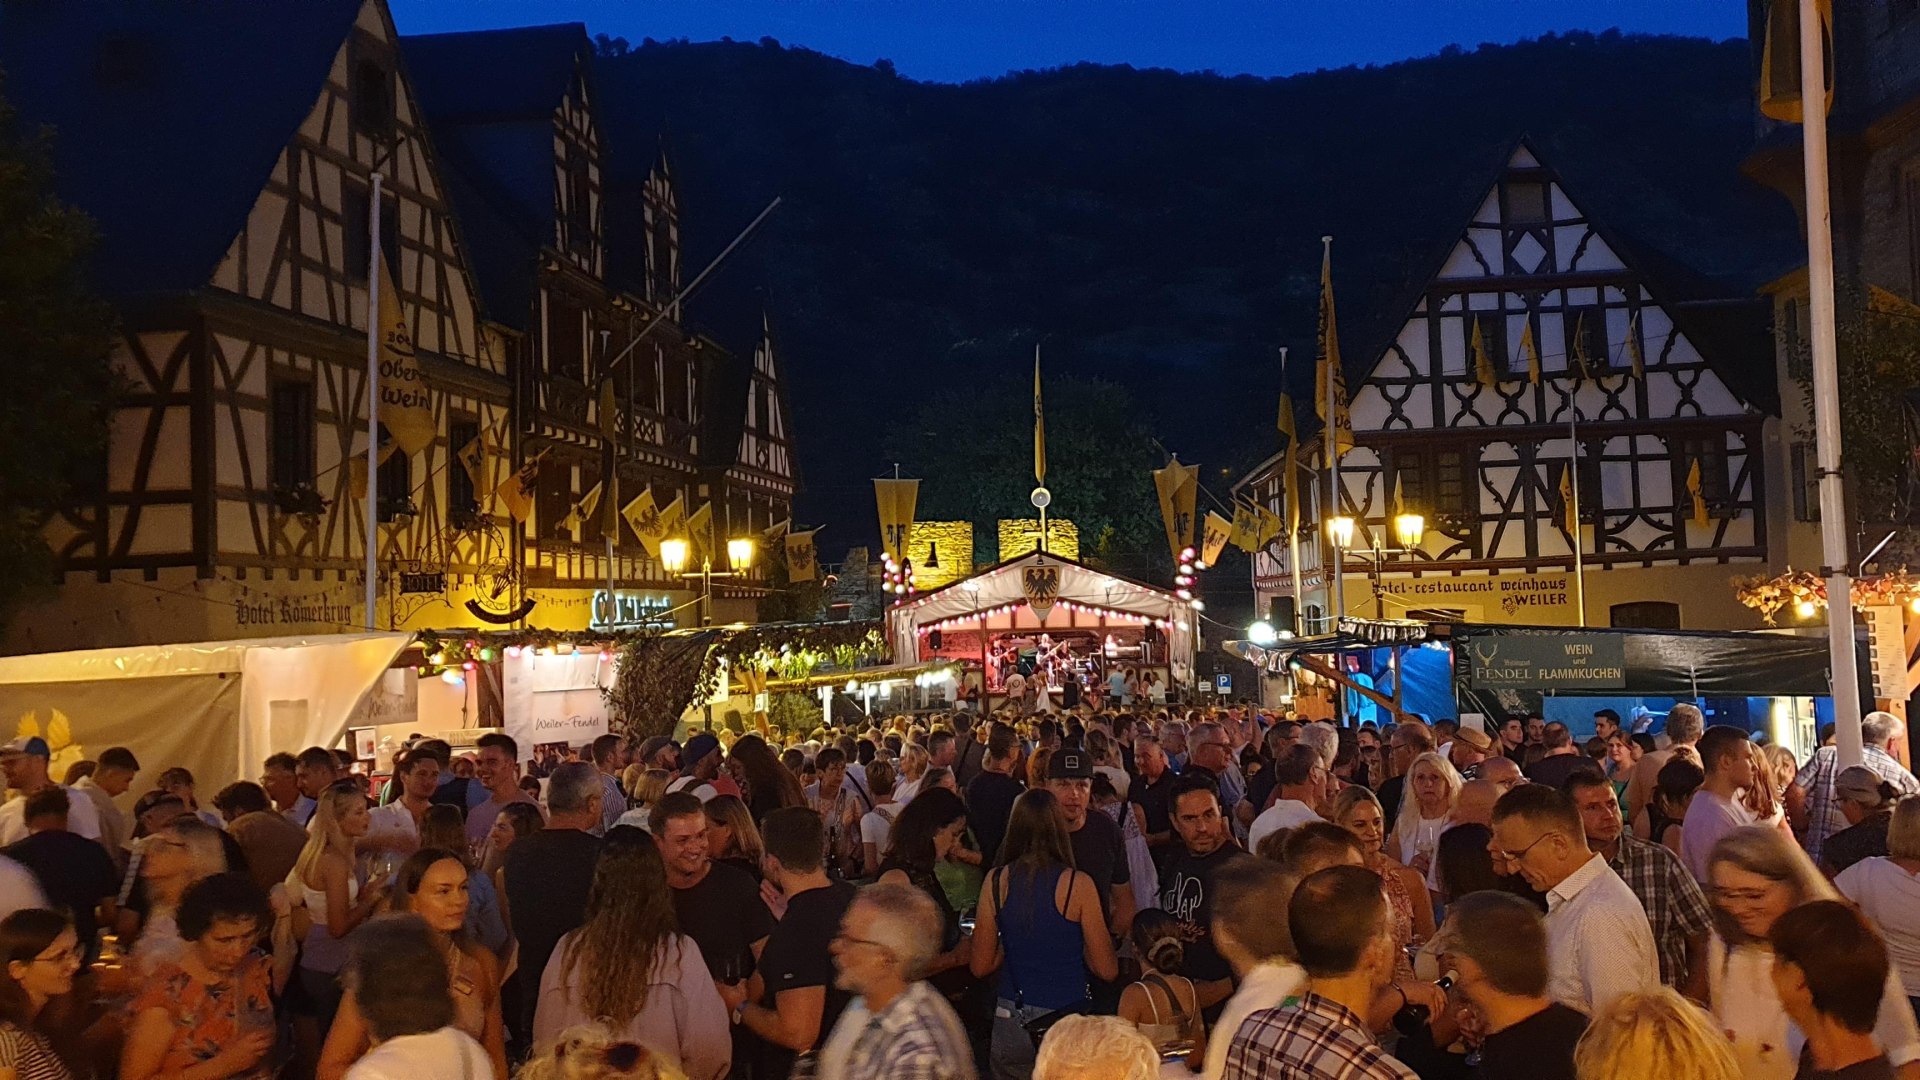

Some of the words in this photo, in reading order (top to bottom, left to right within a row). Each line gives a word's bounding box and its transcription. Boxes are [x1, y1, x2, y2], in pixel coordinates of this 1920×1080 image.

[1501, 576, 1567, 592] weinhaus
[1515, 593, 1567, 606] WEILER
[1564, 644, 1593, 655] WEIN
[1572, 657, 1586, 665] und
[1476, 667, 1532, 680] FENDEL
[1539, 668, 1621, 680] FLAMMKUCHEN
[1220, 676, 1228, 686] P
[535, 715, 600, 731] Weiler-Fendel
